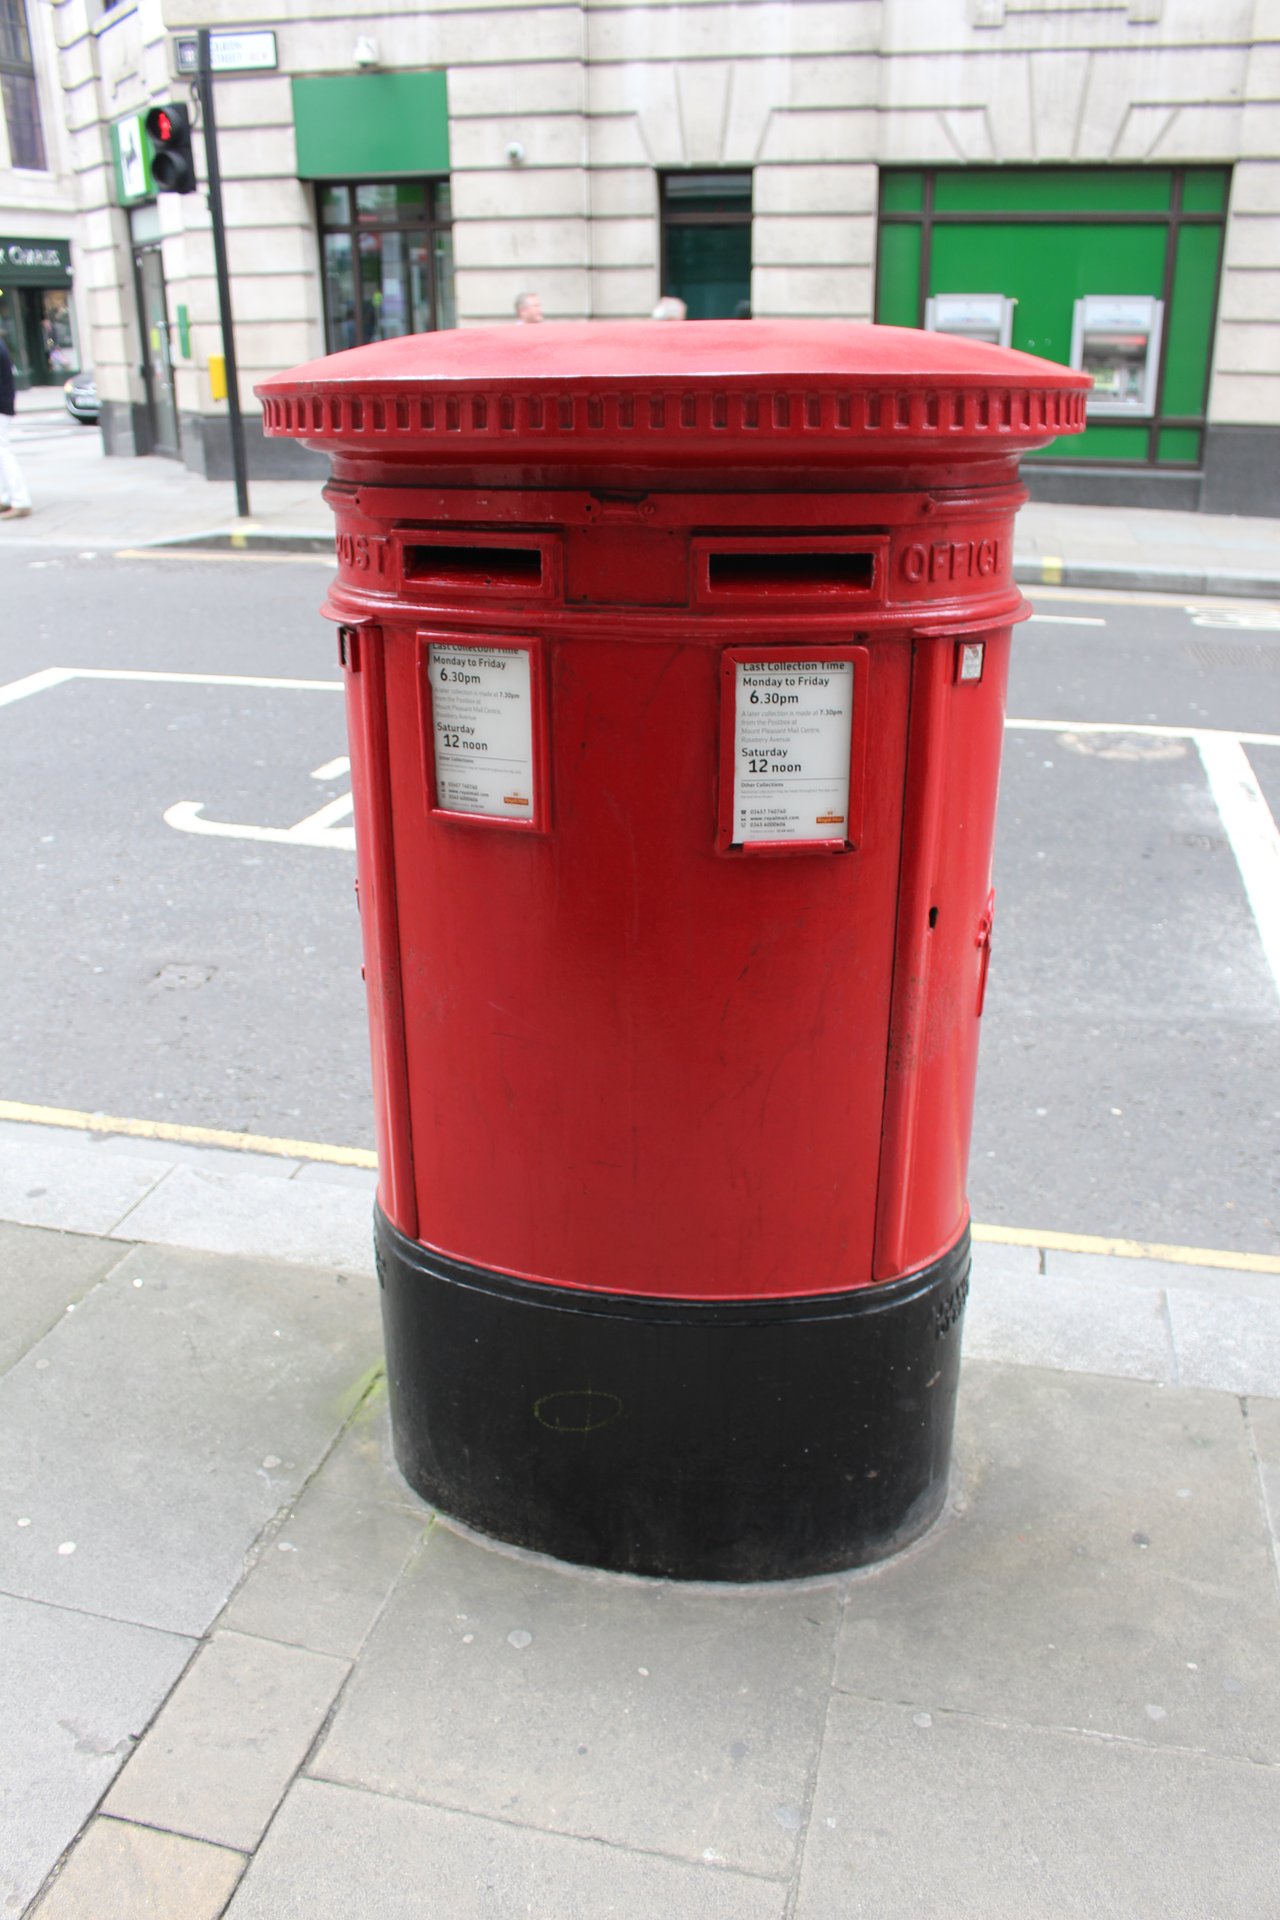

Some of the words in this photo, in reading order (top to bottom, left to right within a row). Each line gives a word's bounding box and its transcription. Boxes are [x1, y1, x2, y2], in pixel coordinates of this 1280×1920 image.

[336, 533, 388, 574] POST
[433, 655, 465, 668] Monday
[468, 658, 477, 667] to
[479, 658, 506, 670] Friday
[743, 662, 765, 671] Last
[767, 662, 818, 671] Collection
[821, 662, 845, 670] Time
[440, 668, 480, 685] 6.30pm
[743, 677, 782, 688] Monday
[785, 678, 795, 686] to
[798, 676, 830, 687] Friday
[750, 690, 799, 706] 6.30pm
[437, 722, 475, 735] Saturday
[443, 734, 460, 748] 12
[462, 741, 488, 750] noon
[742, 748, 788, 758] Saturday
[748, 759, 768, 773] 12
[772, 764, 802, 773] noon
